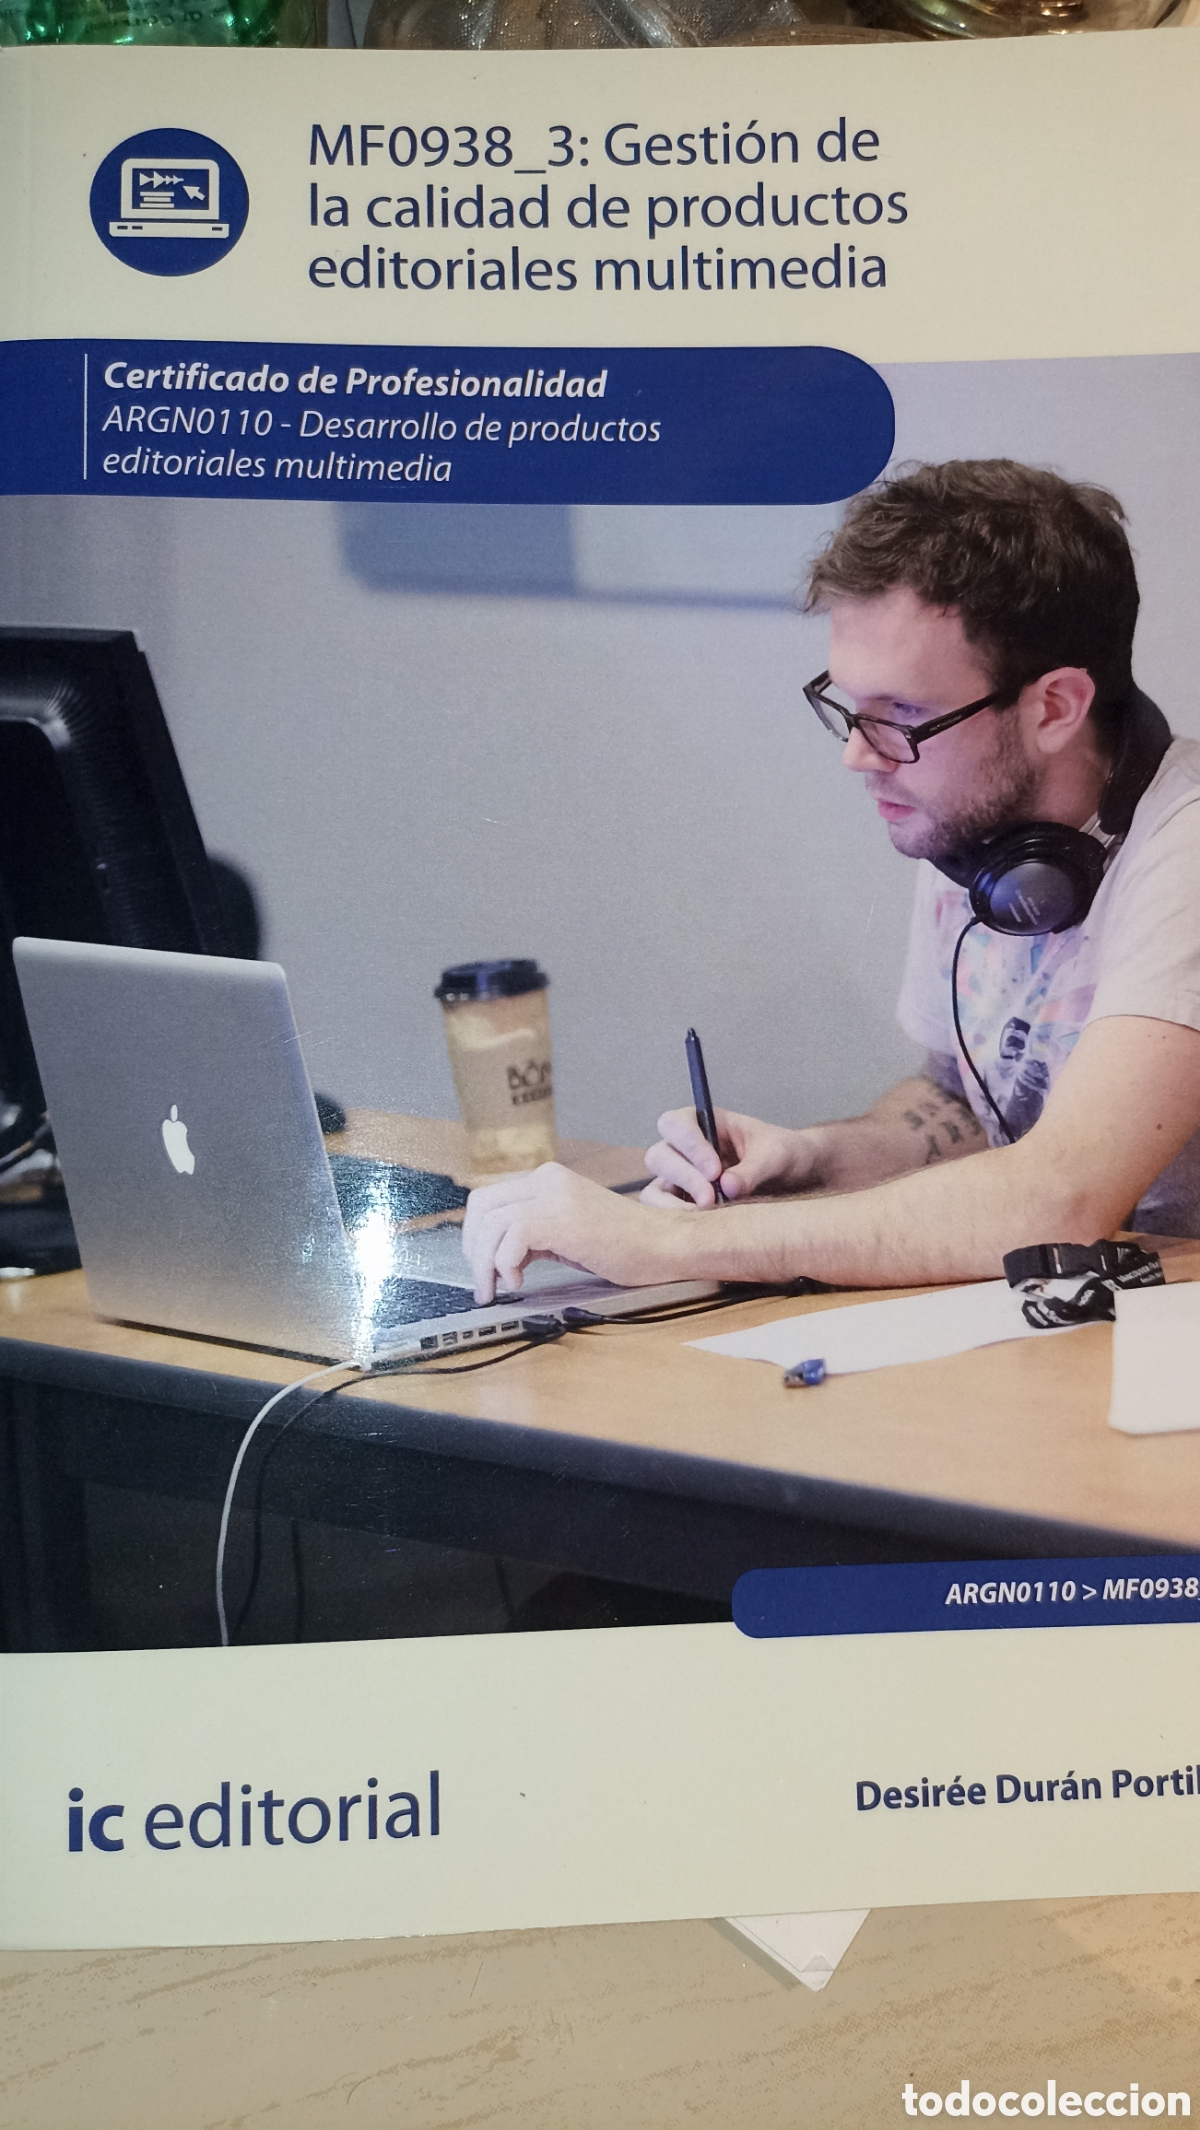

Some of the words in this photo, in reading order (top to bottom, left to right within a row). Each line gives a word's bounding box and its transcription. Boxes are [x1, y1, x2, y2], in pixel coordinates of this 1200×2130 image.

[310, 124, 588, 173] MF0938_3:
[605, 120, 798, 166] Gestión
[817, 117, 879, 162] de
[311, 183, 348, 226] la
[367, 184, 548, 228] calidad
[568, 184, 629, 228] de
[648, 182, 907, 239] productos
[309, 245, 577, 290] editoriales
[596, 243, 886, 290] multimedia
[105, 362, 289, 392] Certificado
[298, 366, 337, 393] de
[346, 368, 607, 397] Profesionalidad
[102, 406, 272, 435] ARGN0110
[300, 411, 456, 440] Desarrollo
[466, 413, 501, 440] de
[509, 414, 661, 448] productos
[103, 446, 265, 477] editoriales
[275, 452, 451, 481] multimedia
[945, 1581, 1076, 1604] ARGN0110
[1103, 1577, 1200, 1600] MF0938
[69, 1788, 124, 1852] ic
[145, 1770, 439, 1850] editorial
[857, 1776, 986, 1811] Desirée
[997, 1771, 1101, 1803] Durán
